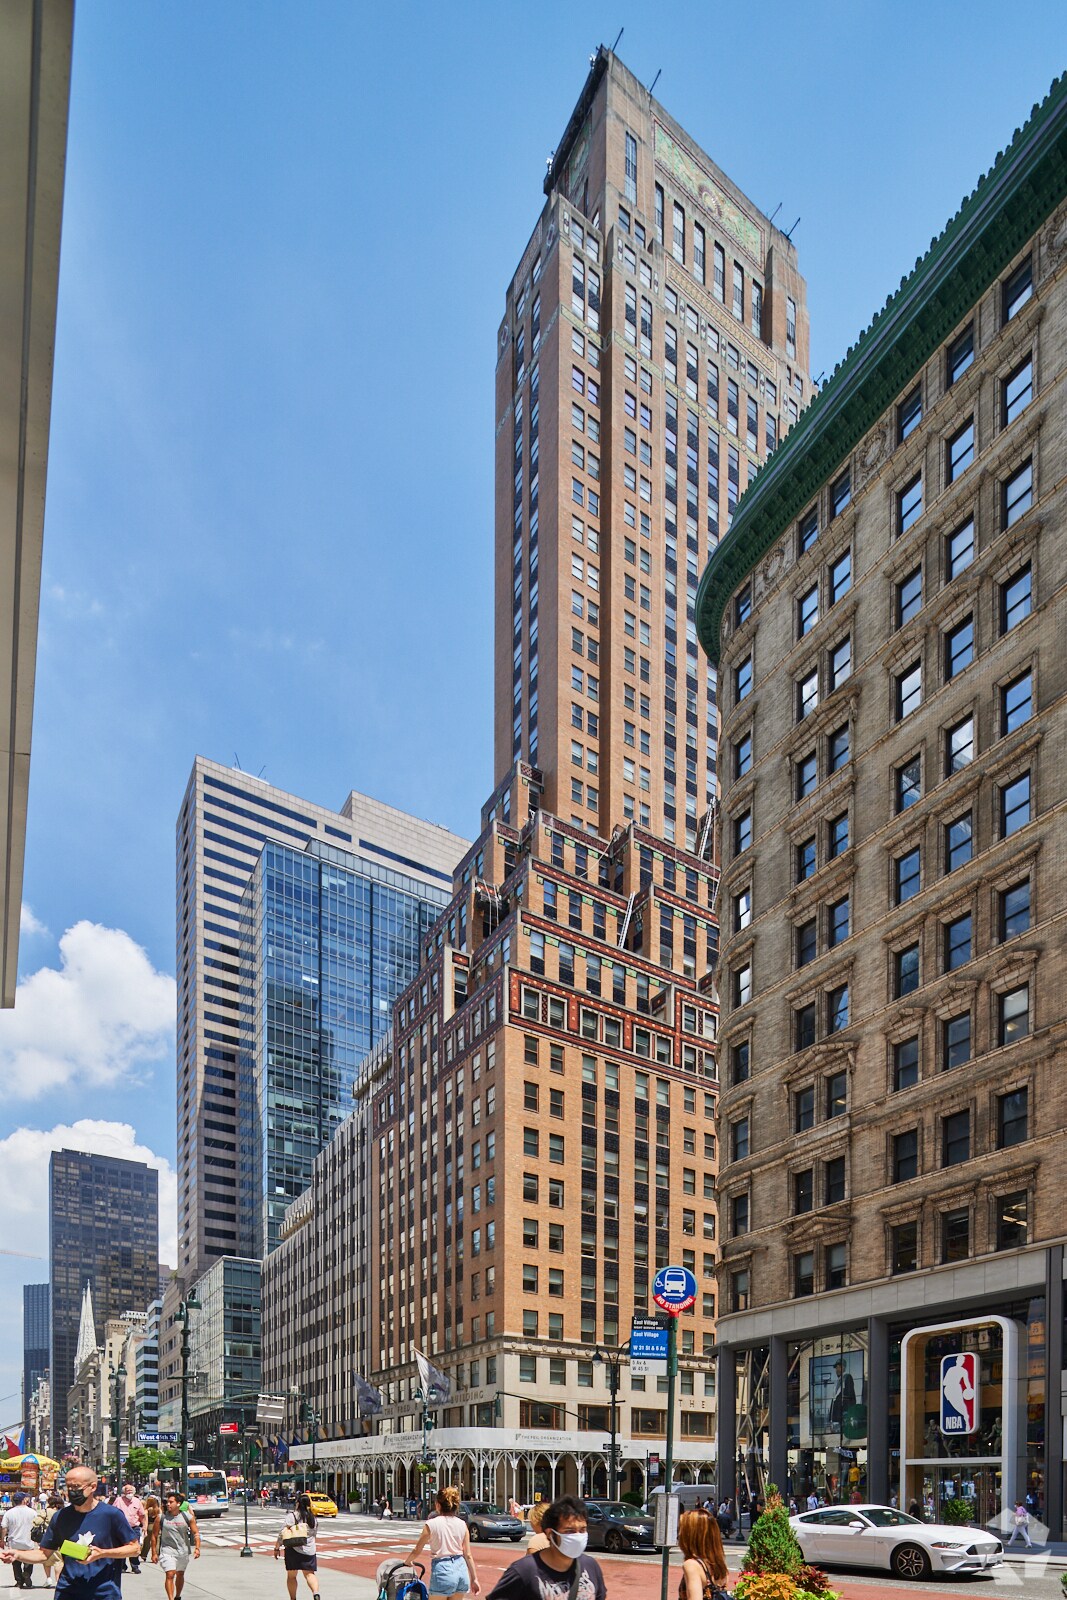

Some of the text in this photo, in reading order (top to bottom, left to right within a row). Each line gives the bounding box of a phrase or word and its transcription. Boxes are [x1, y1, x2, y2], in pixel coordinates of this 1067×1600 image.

[656, 1296, 694, 1309] NO STANDING
[397, 1405, 410, 1413] FRED
[451, 1391, 484, 1404] BUILDING
[945, 1415, 963, 1430] NBA
